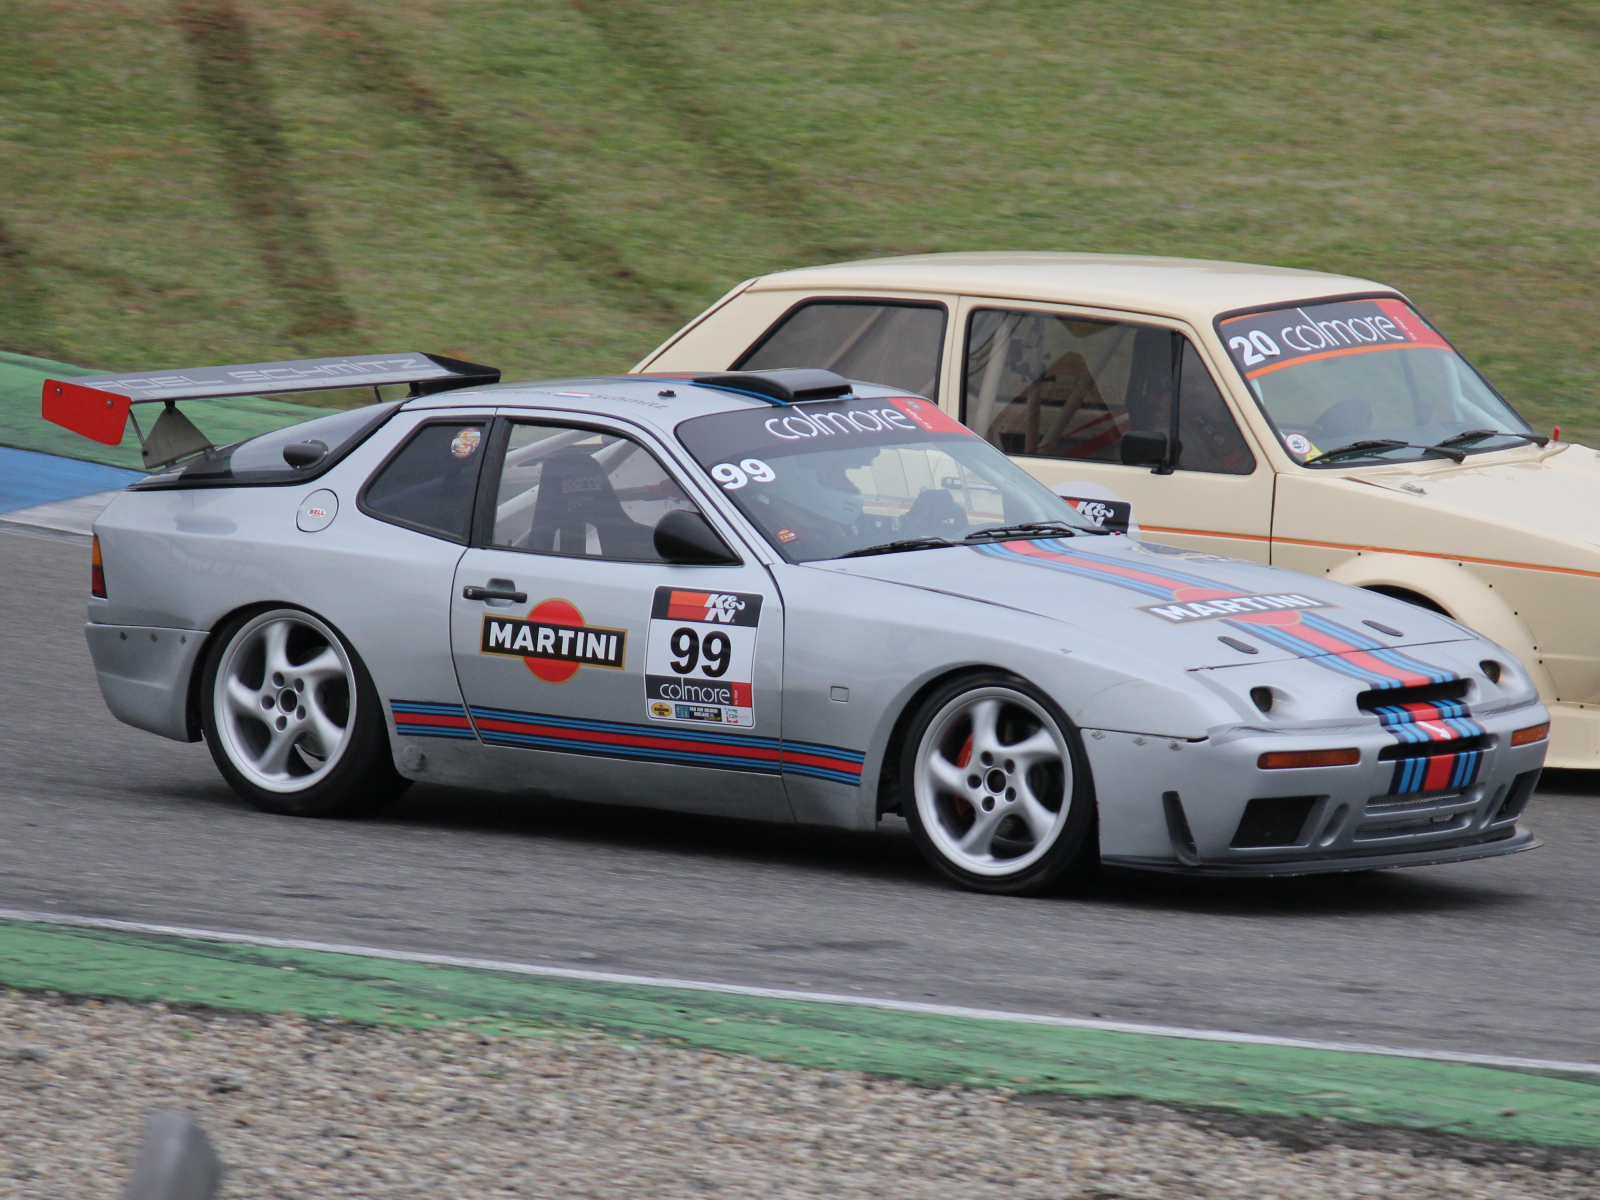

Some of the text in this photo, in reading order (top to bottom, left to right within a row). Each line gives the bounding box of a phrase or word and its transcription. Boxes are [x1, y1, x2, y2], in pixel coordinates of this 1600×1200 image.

[1229, 307, 1404, 366] 20 colmore
[765, 405, 916, 440] colmore
[711, 458, 776, 490] 99
[309, 508, 325, 516] BELL
[704, 593, 745, 623] K&N
[1150, 594, 1324, 620] MARTINI
[489, 621, 618, 661] MARTINI
[670, 627, 731, 678] 99
[660, 677, 731, 704] colmore
